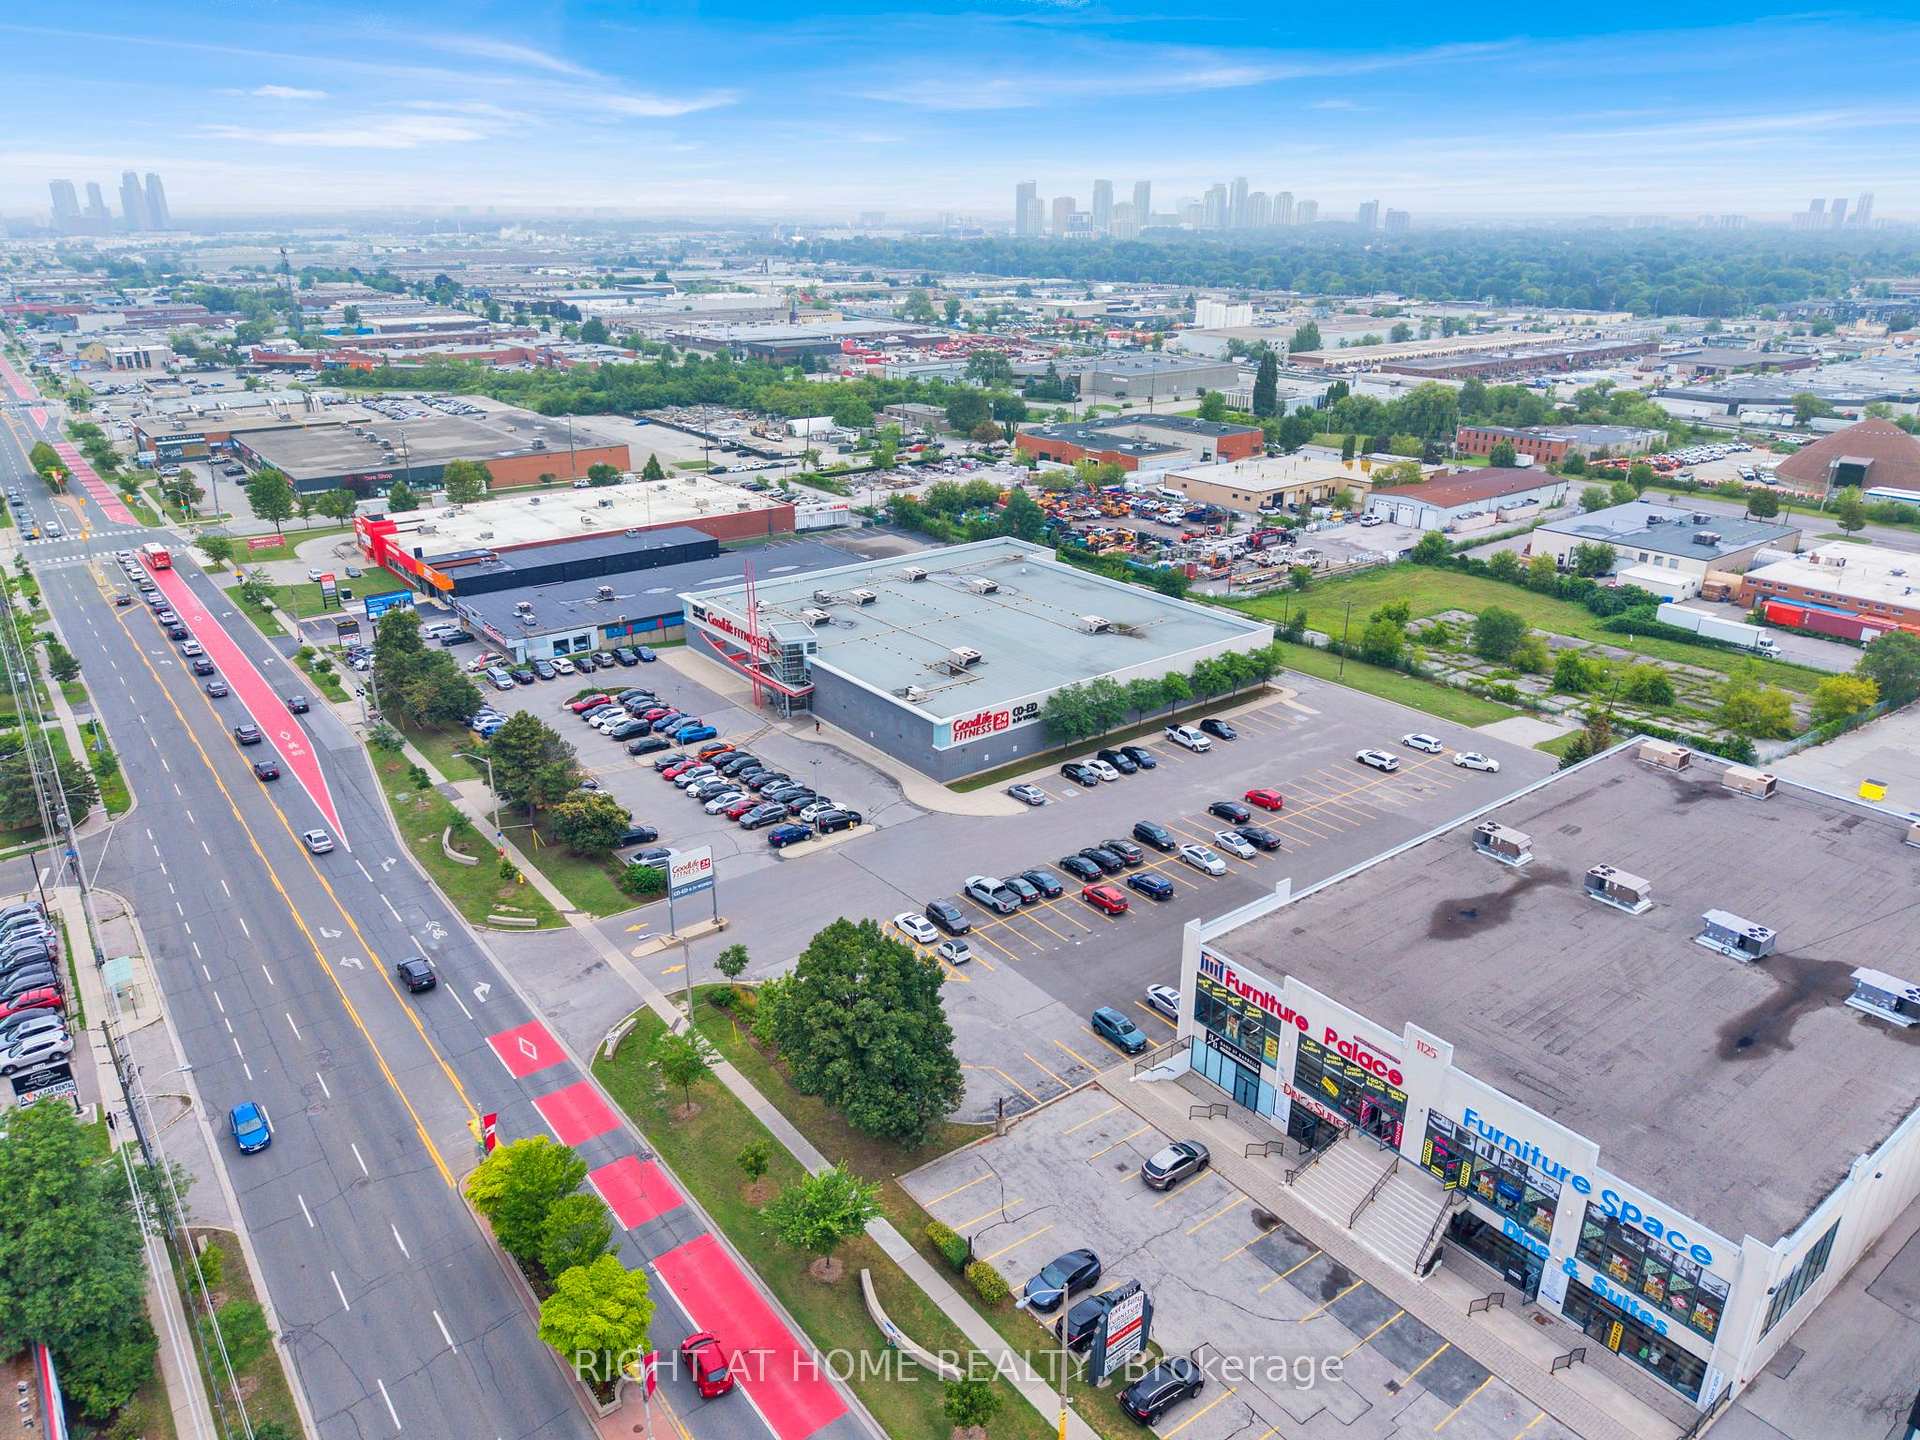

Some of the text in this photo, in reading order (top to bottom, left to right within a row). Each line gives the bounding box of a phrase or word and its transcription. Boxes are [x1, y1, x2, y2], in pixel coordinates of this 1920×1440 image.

[996, 714, 1008, 724] 24
[954, 723, 992, 742] FITNESS
[1225, 970, 1310, 1032] Furniture
[1324, 1024, 1404, 1086] Palace
[1416, 1038, 1439, 1060] 1125
[55, 1083, 74, 1092] RENTAL
[1463, 1107, 1713, 1266] Furniture Space
[1503, 1216, 1550, 1260] Dine
[1562, 1258, 1581, 1280] &
[1590, 1275, 1669, 1337] Suites
[1122, 1288, 1138, 1300] 1125
